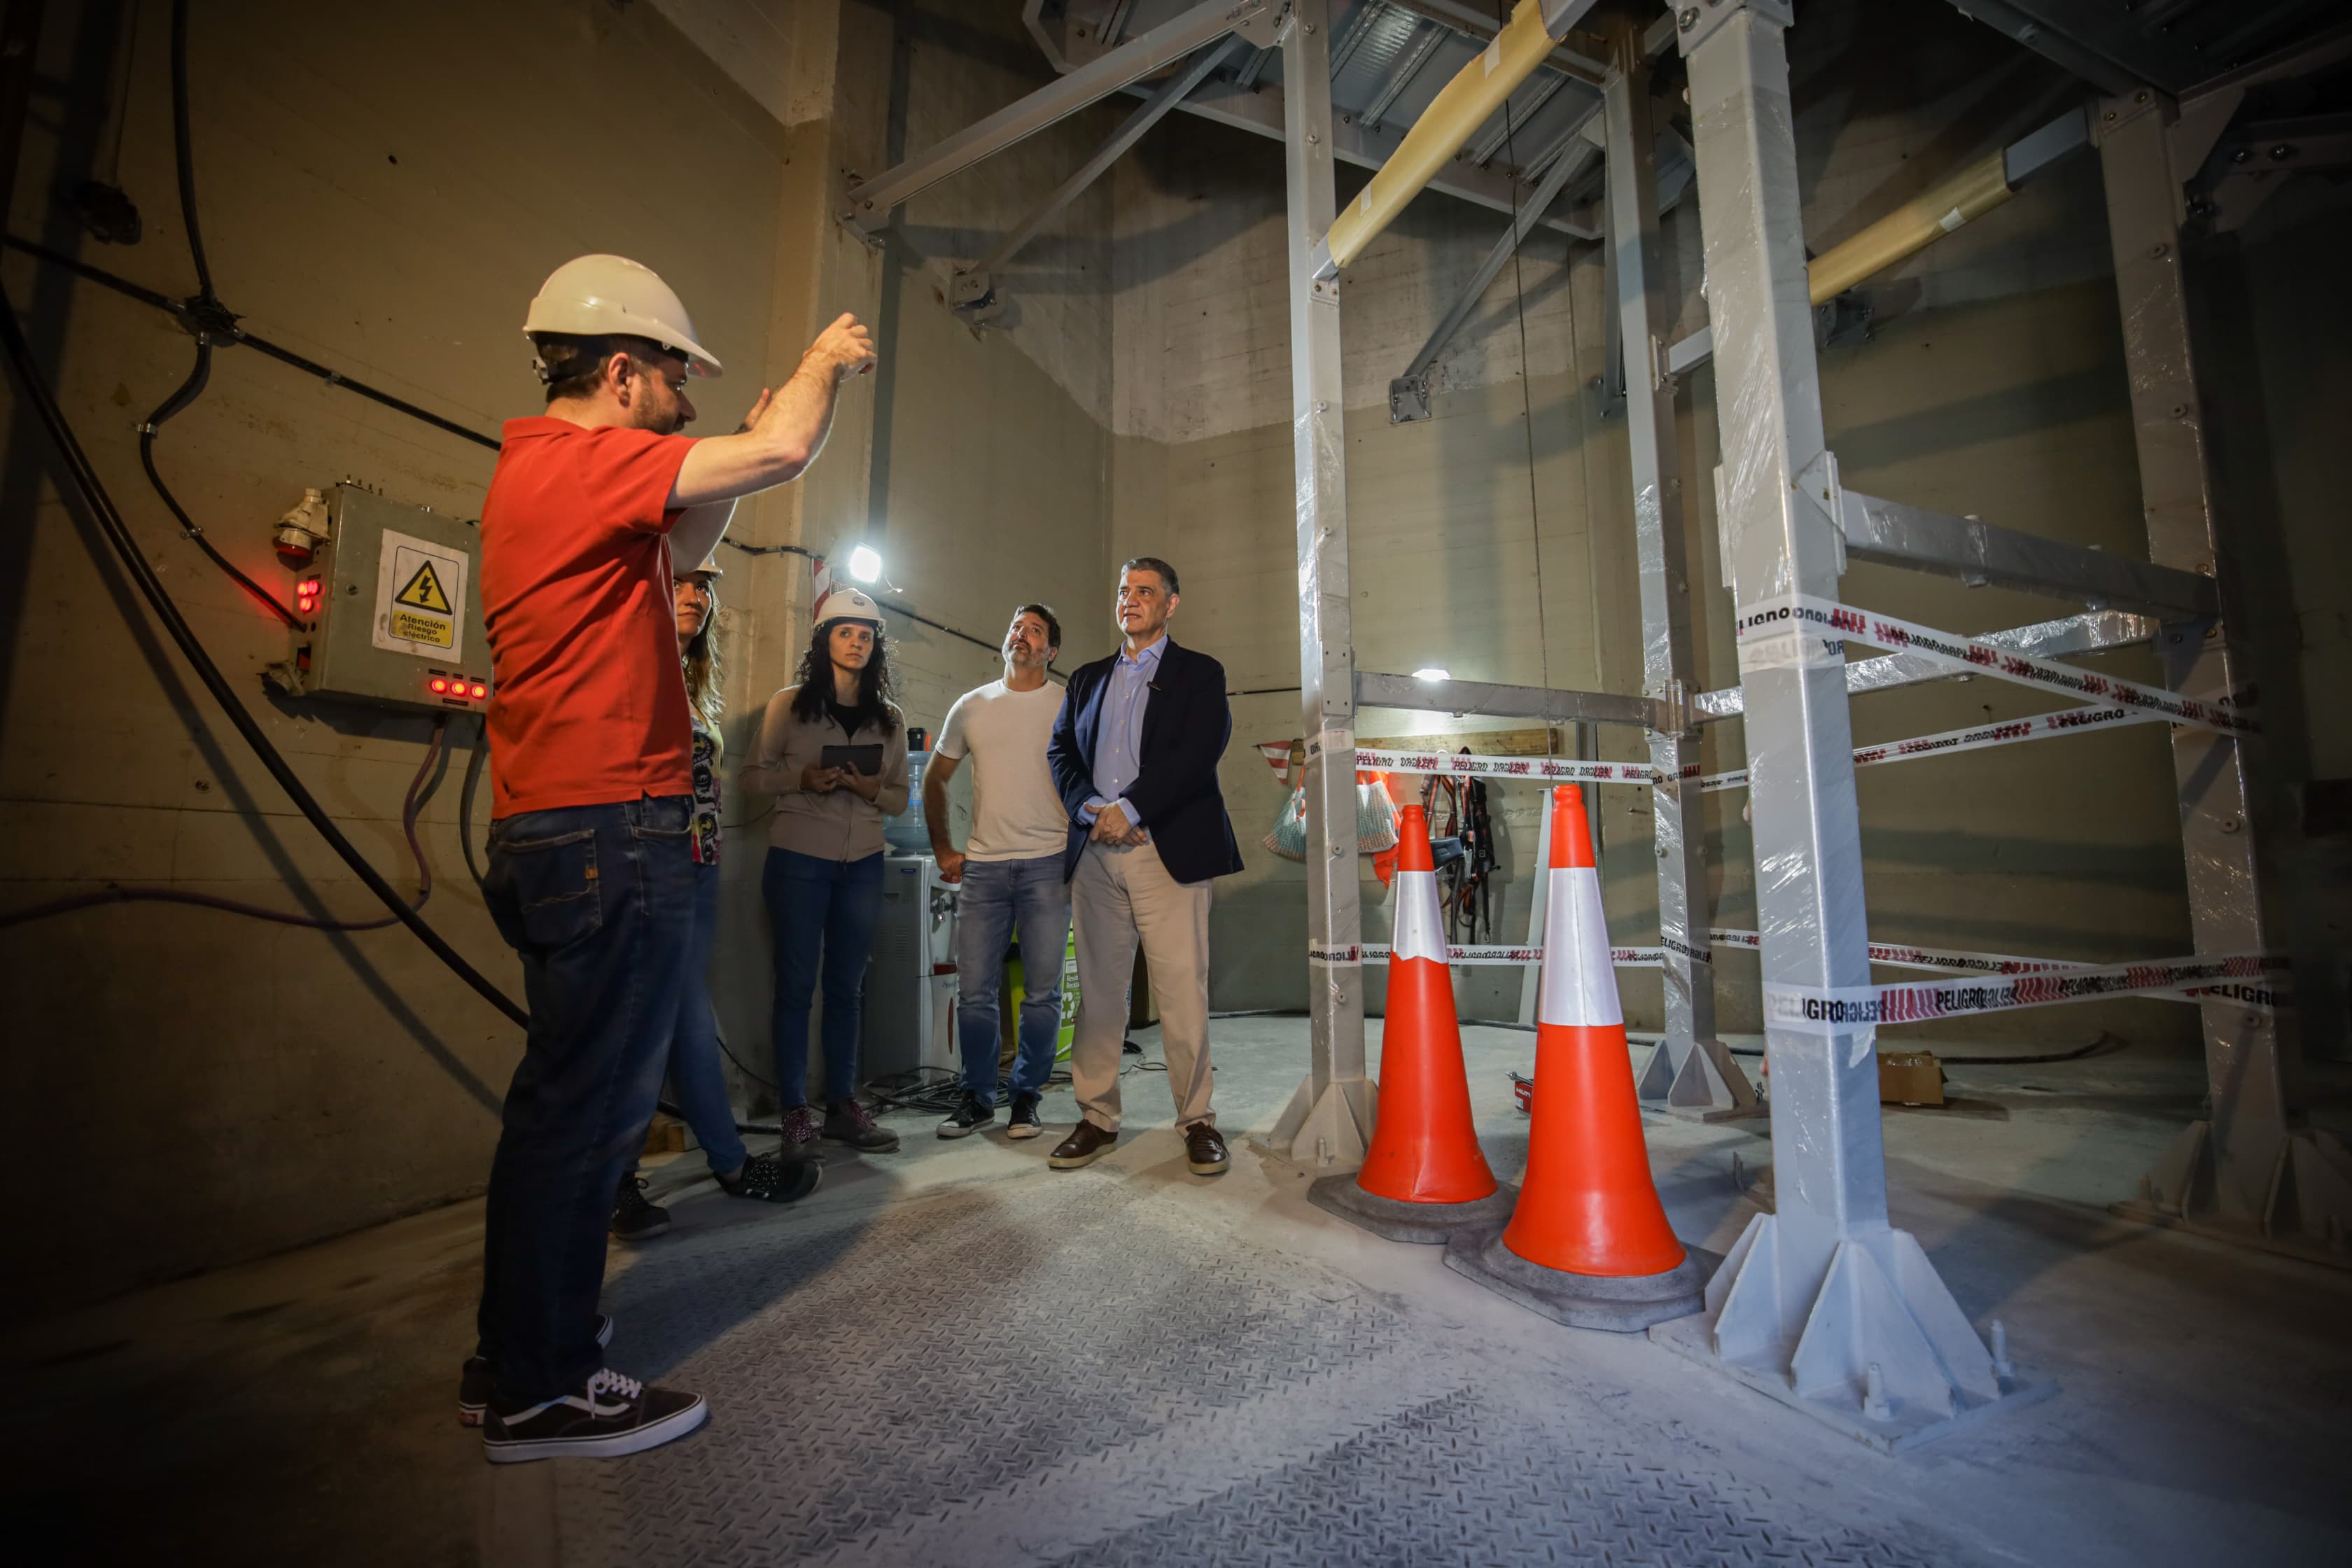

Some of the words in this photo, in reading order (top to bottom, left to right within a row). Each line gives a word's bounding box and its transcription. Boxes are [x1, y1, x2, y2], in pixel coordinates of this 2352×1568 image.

[400, 614, 446, 630] Atención
[408, 623, 438, 635] Riesgo
[1936, 988, 1985, 1014] PELIGRO
